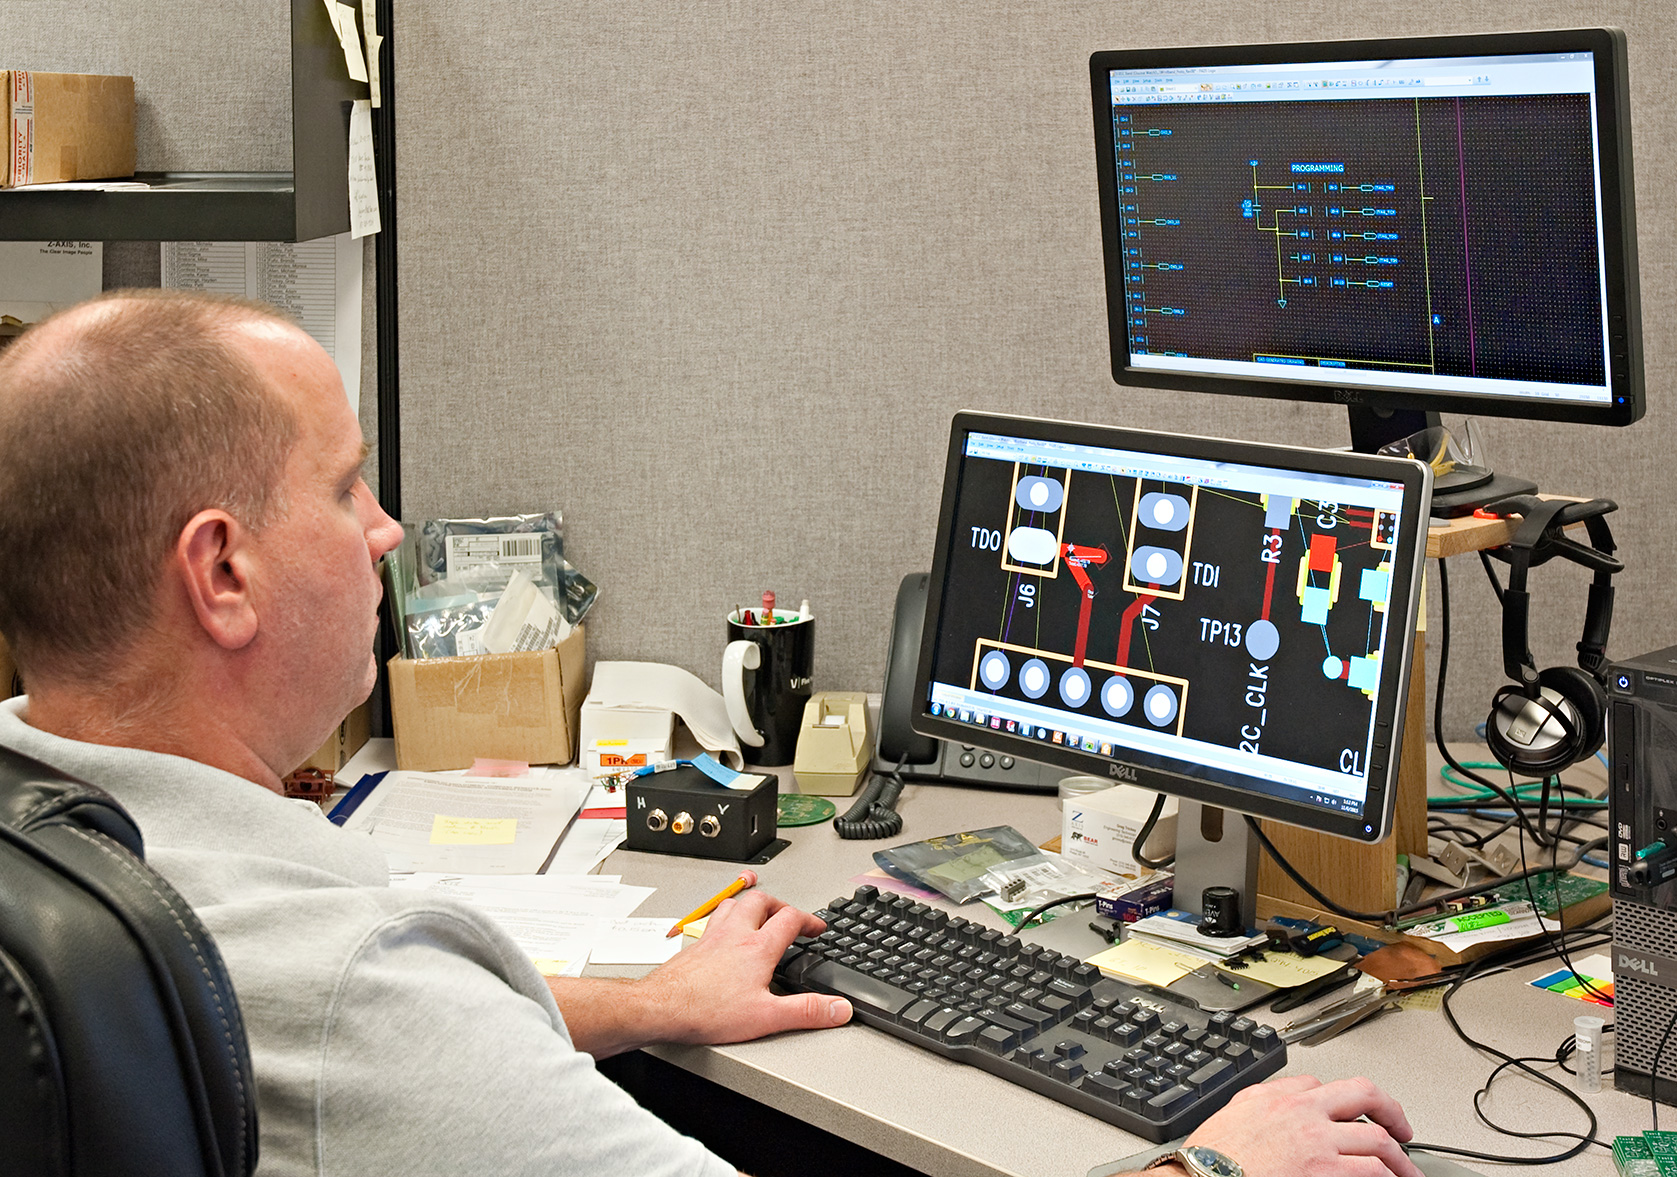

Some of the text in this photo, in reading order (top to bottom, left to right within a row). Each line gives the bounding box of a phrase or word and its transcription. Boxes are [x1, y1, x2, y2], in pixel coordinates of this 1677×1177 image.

[1291, 163, 1344, 172] PROGRAMMING
[47, 241, 93, 249] Z-AXIS, Inc.
[1433, 315, 1440, 324] A
[1333, 389, 1364, 403] DELL
[1316, 501, 1339, 529] C3
[971, 526, 1001, 551] TDO
[1261, 534, 1283, 564] R3
[1192, 561, 1220, 588] TDI
[1018, 583, 1037, 608] J6
[1141, 603, 1161, 630] J7
[1199, 618, 1242, 648] TP13
[1645, 676, 1674, 685] OPTIPLEX
[1239, 662, 1269, 754] 2C_CLK
[1339, 748, 1364, 776] CL
[1109, 763, 1137, 781] DELL
[636, 796, 646, 809] H
[1072, 810, 1083, 823] Z
[1083, 836, 1098, 844] BEAR
[1621, 845, 1627, 858] RW
[1098, 900, 1113, 910] T-Pins
[1145, 905, 1160, 915] T-Pins
[1456, 911, 1503, 923] ACCEPTED
[1618, 955, 1658, 977] DELL
[1130, 996, 1165, 1013] DELL
